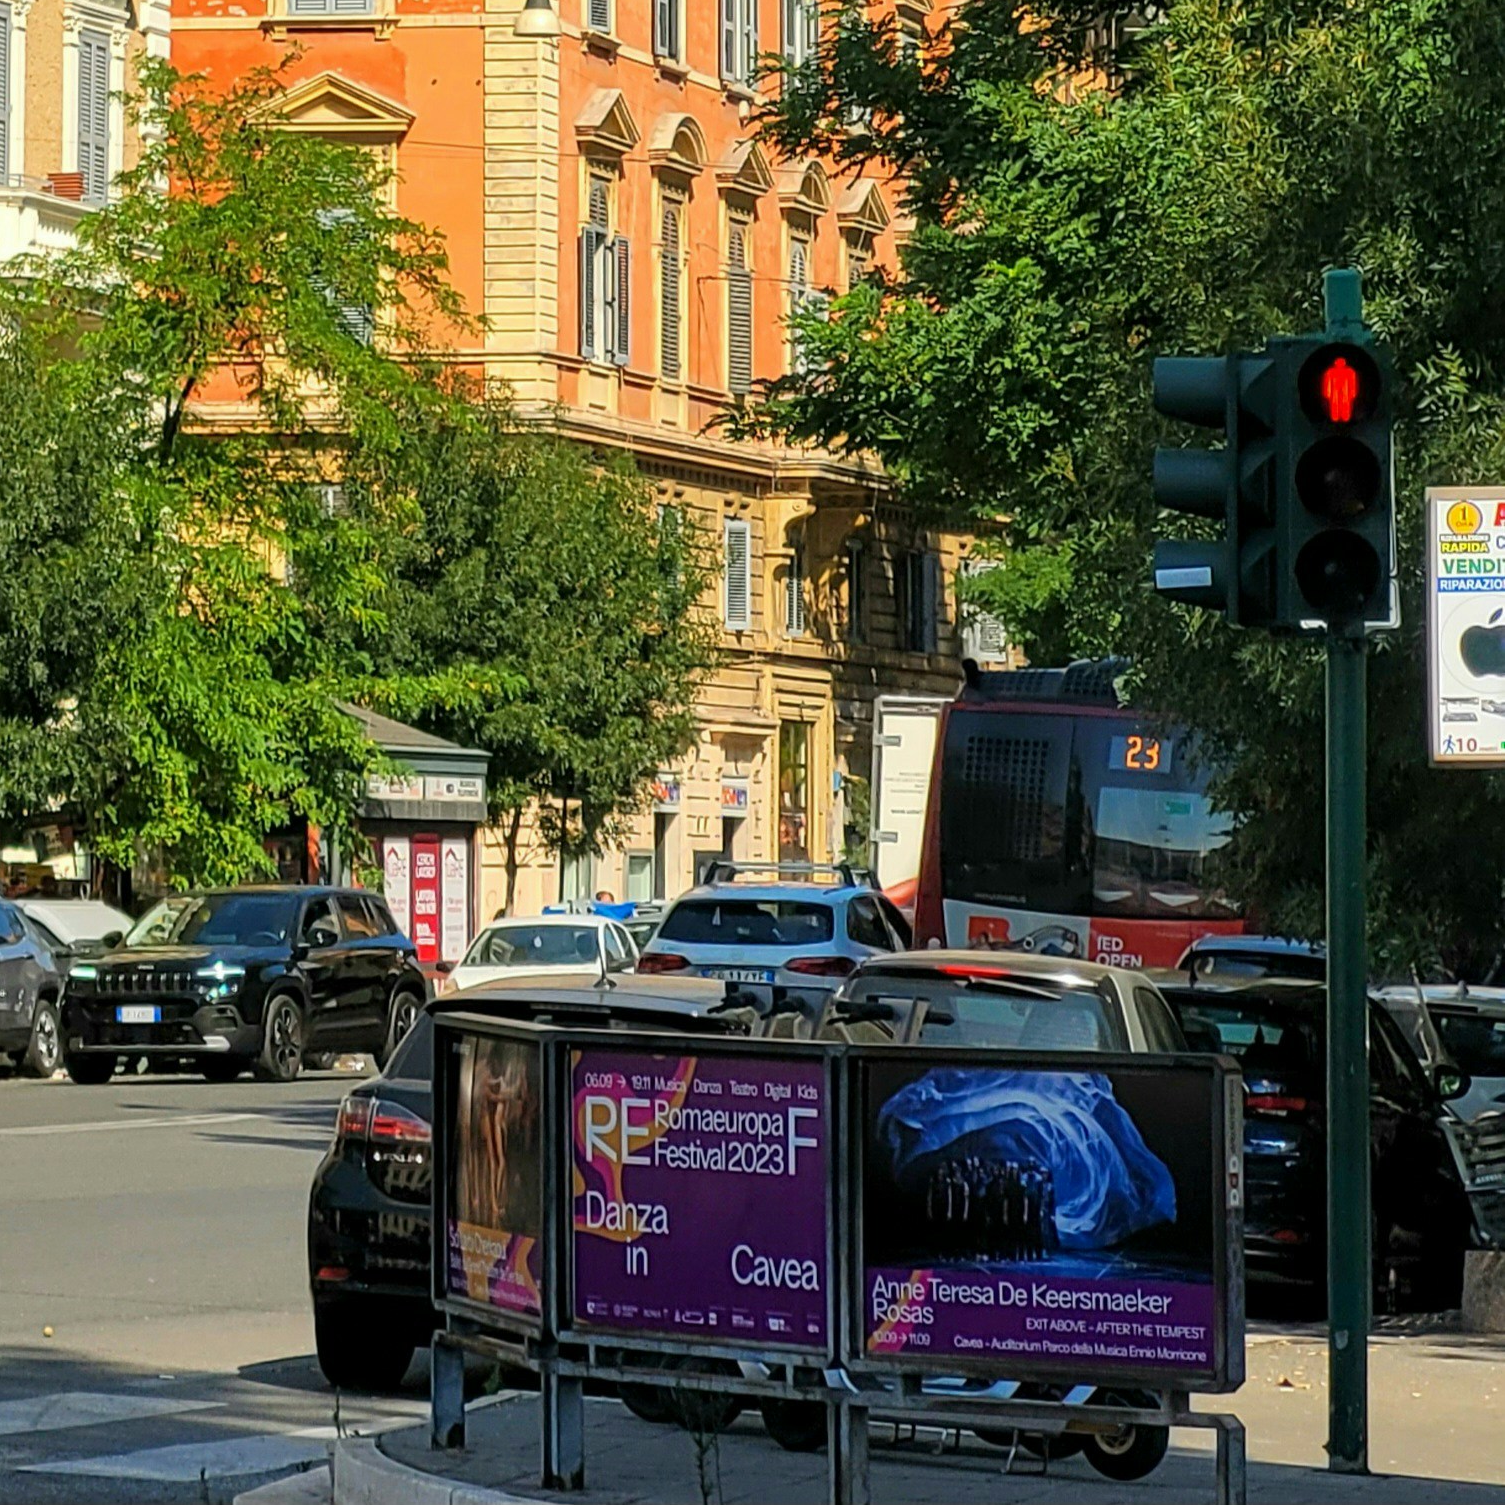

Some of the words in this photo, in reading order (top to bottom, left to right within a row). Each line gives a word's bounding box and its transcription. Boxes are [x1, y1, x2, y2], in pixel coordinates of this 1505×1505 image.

[1460, 505, 1467, 521] 1
[1441, 542, 1489, 553] RAPIDA
[1443, 558, 1505, 574] VENDI
[1440, 578, 1505, 591] RIPARAZIO
[1125, 735, 1161, 769] 23
[1456, 737, 1477, 752] 10
[1095, 952, 1142, 968] OPEN
[585, 1072, 613, 1089] 06.09
[631, 1074, 651, 1091] 19.11
[654, 1076, 688, 1094] Musica
[694, 1078, 722, 1095] Danza
[729, 1080, 758, 1097] Teatro
[764, 1083, 792, 1101] Digital
[797, 1084, 818, 1100] Kids
[585, 1095, 651, 1166] RE
[654, 1099, 784, 1142] Romaeuropa
[788, 1106, 818, 1176] F
[654, 1137, 726, 1172] Festival
[727, 1142, 785, 1175] 2023
[586, 1190, 669, 1235] Danza
[626, 1236, 648, 1277] in
[731, 1244, 820, 1291] Cavea
[872, 1274, 925, 1301] Anne
[927, 1278, 994, 1305] Teresa
[998, 1281, 1028, 1307] De
[1032, 1283, 1172, 1314] Keersmaeker
[872, 1297, 935, 1325] Rosas
[908, 1332, 931, 1345] 11.09
[1026, 1317, 1048, 1331] EXIT
[1049, 1319, 1087, 1333] ABOVE
[1095, 1321, 1131, 1335] AFTER
[1132, 1323, 1153, 1337] THE
[1155, 1324, 1206, 1339] TEMPEST
[953, 1334, 984, 1349] Cavea
[991, 1337, 1041, 1352] Auditorium
[1042, 1340, 1071, 1354] Parco
[1071, 1341, 1094, 1355] della
[1094, 1342, 1128, 1357] Musica
[1129, 1345, 1156, 1359] Ennio
[1157, 1346, 1207, 1362] Morricone
